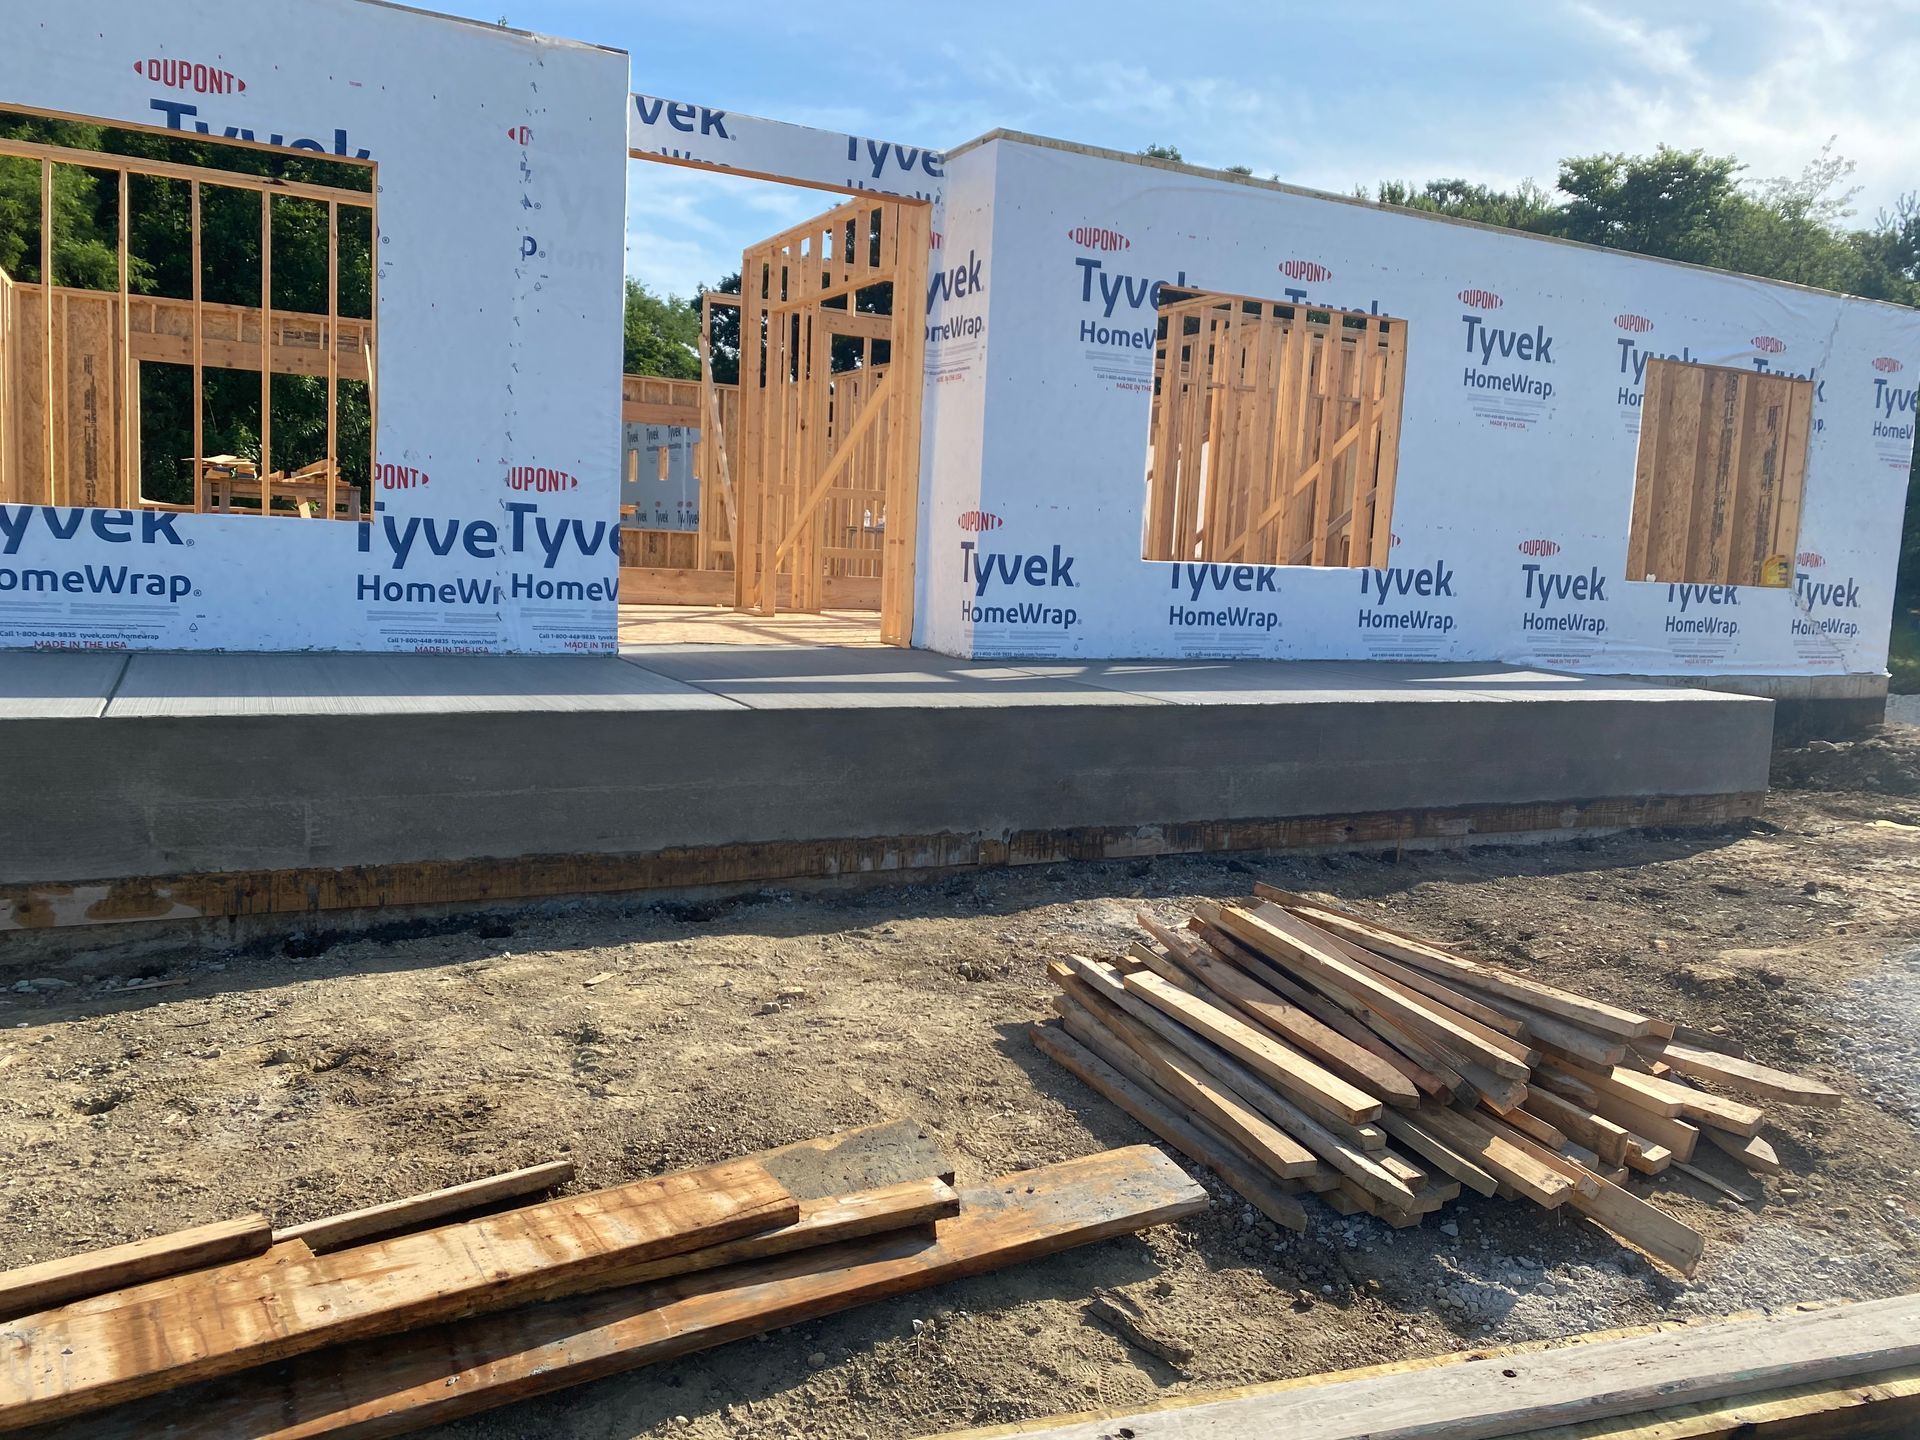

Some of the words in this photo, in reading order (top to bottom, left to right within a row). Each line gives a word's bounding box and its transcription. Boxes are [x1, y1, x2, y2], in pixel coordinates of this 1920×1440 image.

[147, 58, 235, 95] DUPONT
[1075, 227, 1125, 251] DUPONT
[1284, 260, 1327, 283] DUPONT
[1463, 289, 1500, 310] DUPONT
[1618, 313, 1650, 333] DUPONT
[1462, 314, 1553, 366] Tyvek
[1463, 367, 1553, 401] HomeWrap
[505, 466, 569, 492] UPONT
[961, 511, 997, 532] DUPONT
[1523, 539, 1558, 557] DUPONT
[960, 541, 1075, 597] Tyvek
[1522, 563, 1606, 609] Tyvek
[1795, 572, 1860, 613] Tyvek
[961, 600, 1077, 630] HomeWrap
[1168, 605, 1279, 632] HomeWrap
[1358, 609, 1454, 634] HomeWrap
[1523, 612, 1606, 636] HomeWrap
[1665, 615, 1738, 637] HomeWrap
[34, 640, 67, 649] MADE
[69, 641, 81, 649] IN
[82, 641, 104, 649] THE
[106, 641, 128, 649] USA
[415, 645, 441, 654] MADE
[442, 646, 452, 654] IN
[454, 646, 470, 654] THE
[472, 646, 489, 654] USA
[564, 641, 588, 650] MADE
[589, 642, 599, 650] IN
[600, 642, 616, 650] THE
